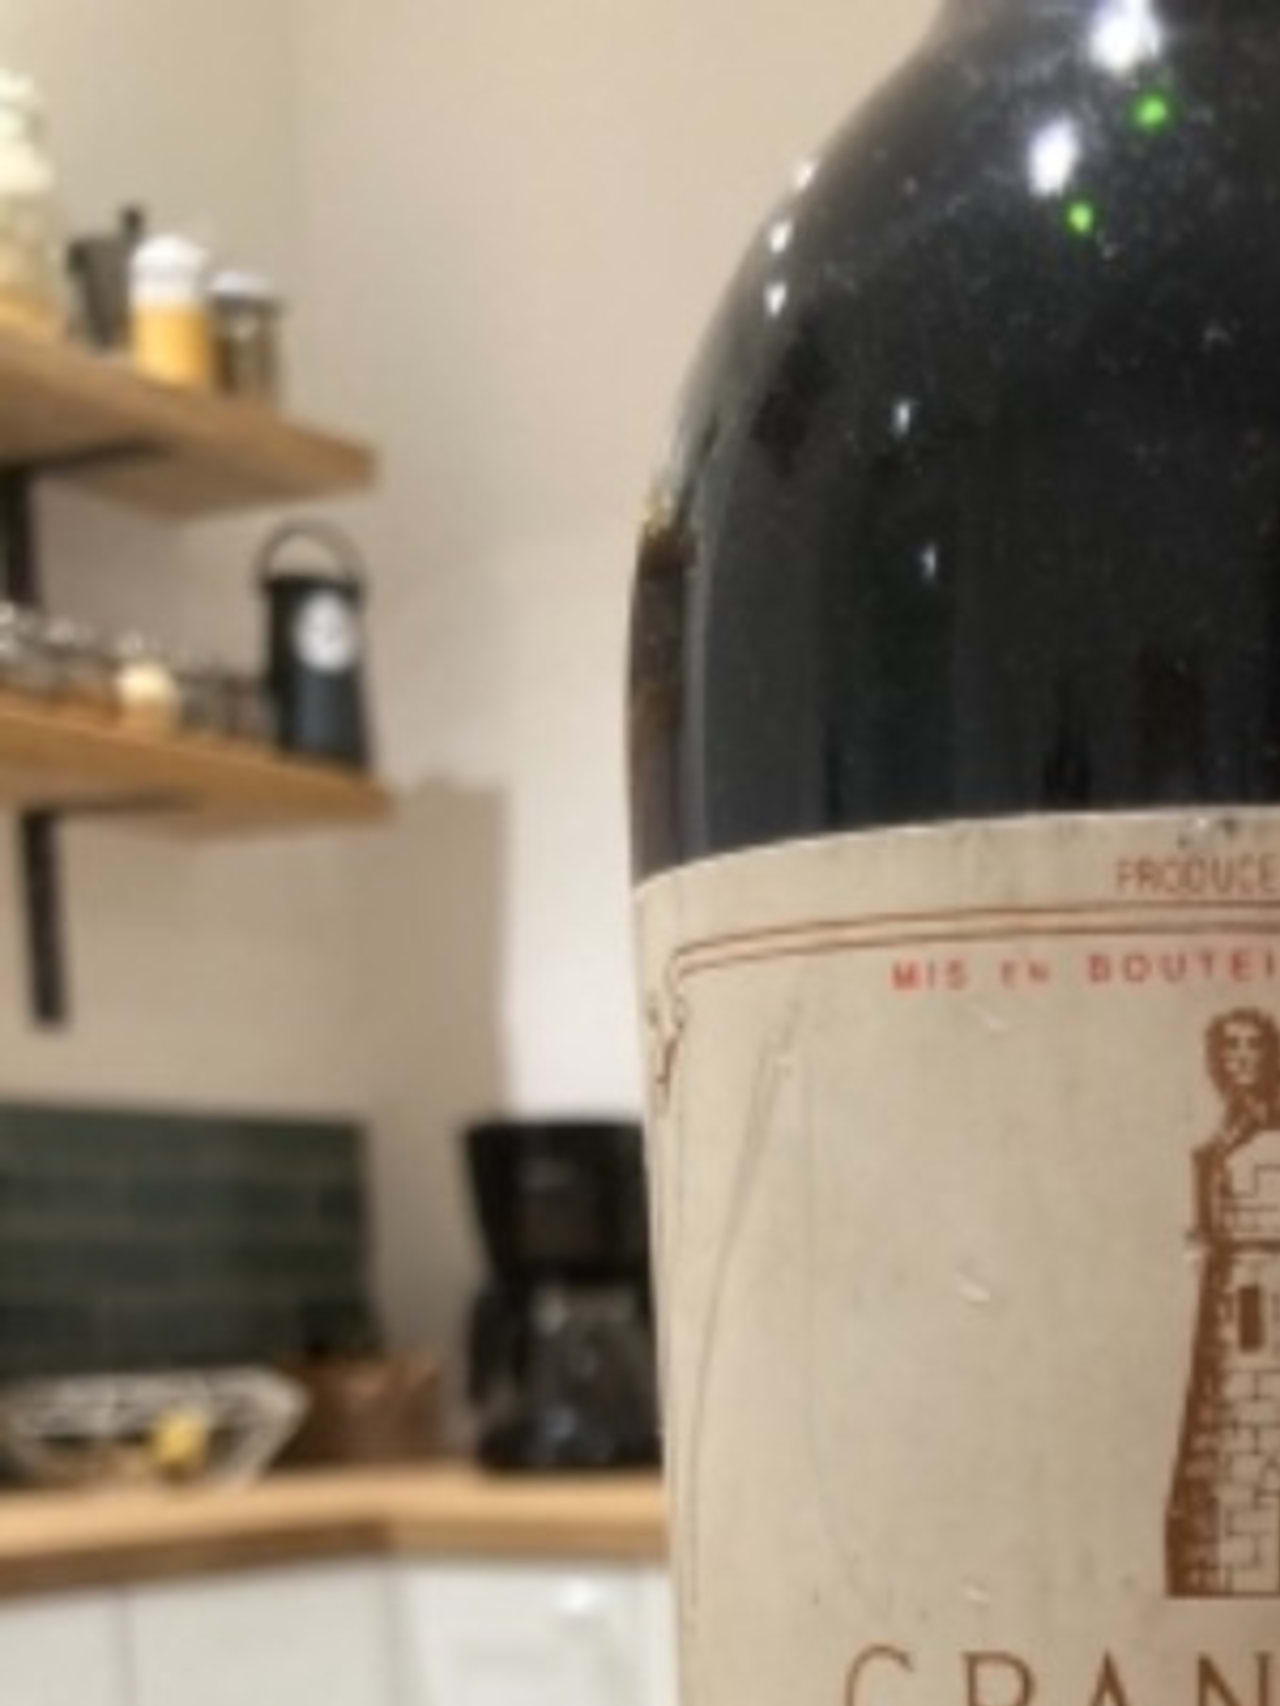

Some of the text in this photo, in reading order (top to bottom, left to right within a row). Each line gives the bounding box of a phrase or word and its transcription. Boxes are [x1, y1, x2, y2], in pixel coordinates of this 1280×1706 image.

[1115, 853, 1278, 895] PRODUCE
[891, 957, 970, 991] MIS
[1000, 958, 1052, 990] EN
